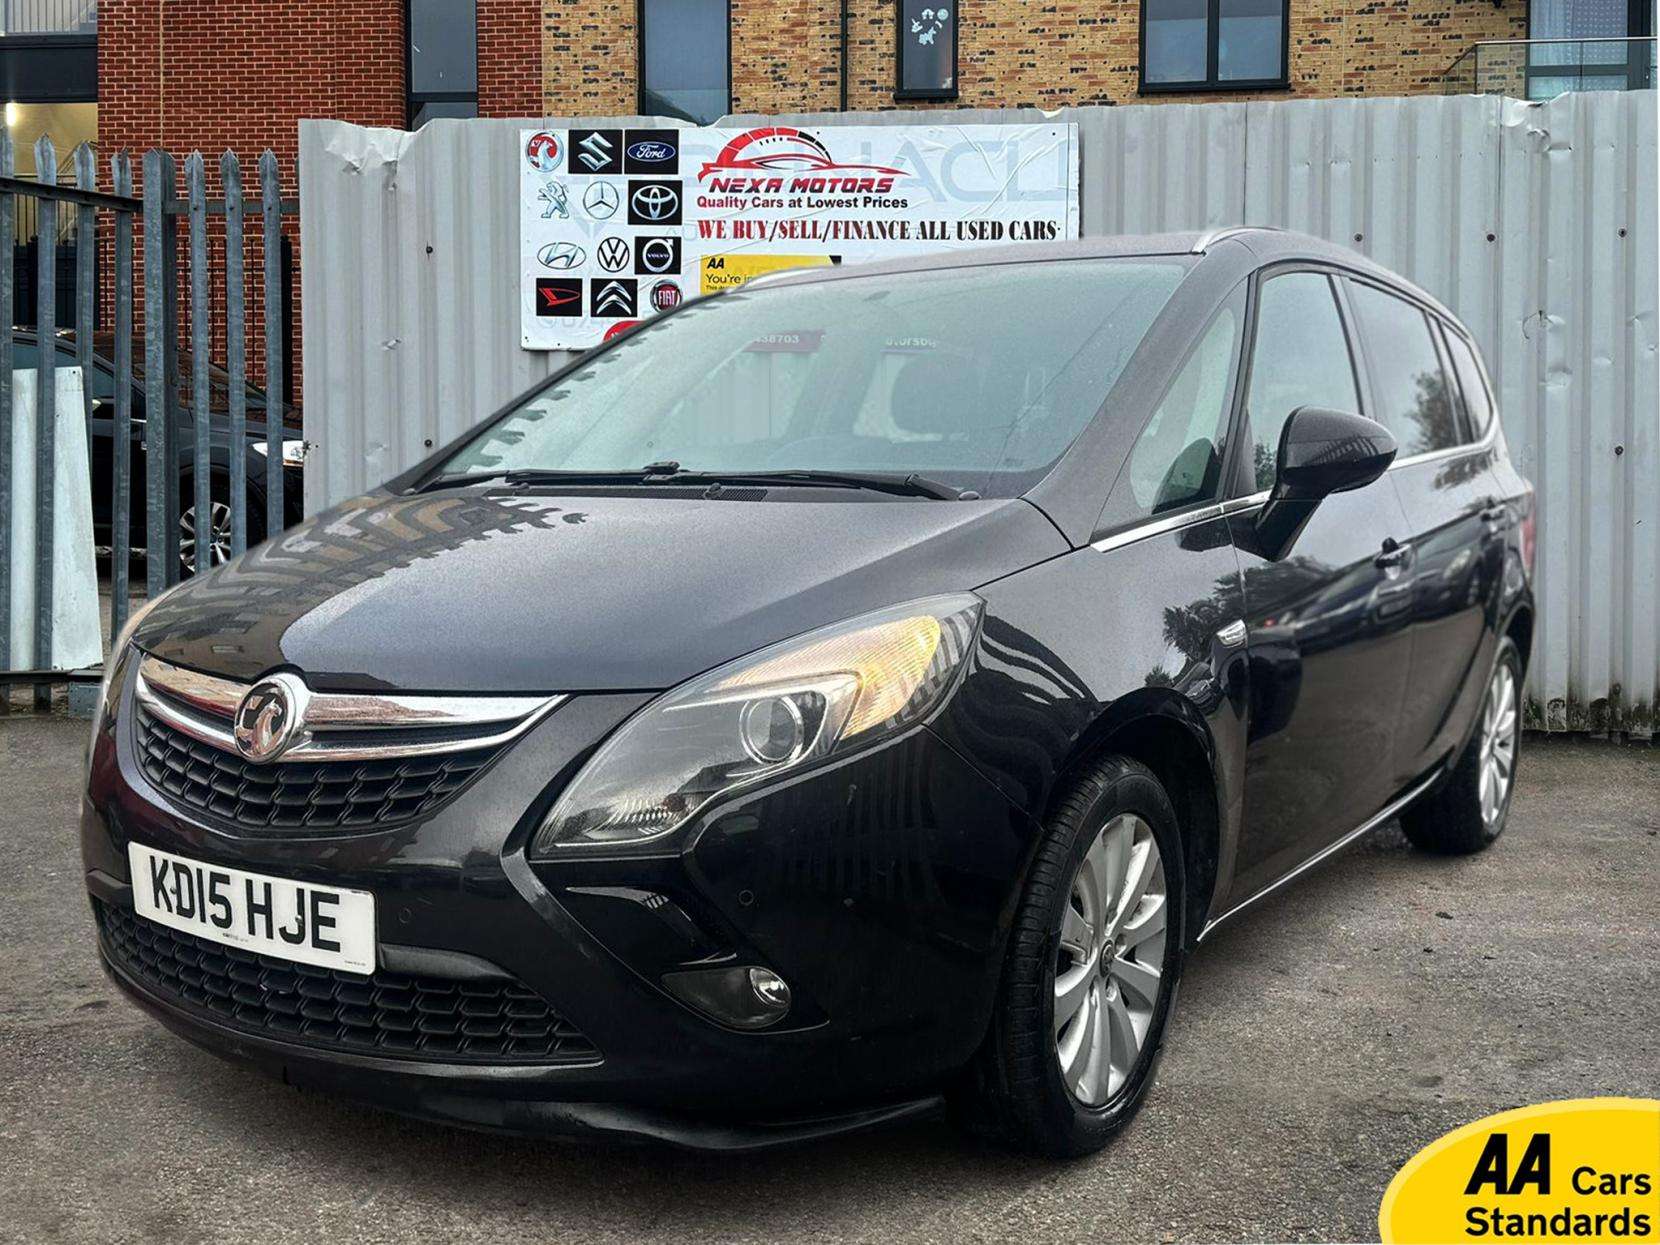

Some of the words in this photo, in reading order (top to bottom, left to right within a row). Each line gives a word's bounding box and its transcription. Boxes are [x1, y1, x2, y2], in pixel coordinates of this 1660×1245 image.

[636, 144, 666, 159] Ford
[709, 178, 781, 193] NEXA
[790, 178, 894, 193] MOTORS
[697, 196, 747, 210] Quality
[752, 196, 784, 208] Cars
[788, 197, 803, 208] at
[807, 196, 858, 208] Lowest
[863, 196, 908, 208] Prices
[698, 220, 727, 240] WE
[733, 220, 911, 242] BUY/SELL/FINANCE
[916, 221, 953, 240] ALL
[957, 221, 1003, 240] USED
[1009, 221, 1057, 240] CARS
[707, 257, 725, 269] AA
[706, 274, 741, 284] You're
[658, 290, 675, 306] FIAT
[150, 855, 233, 929] KD15
[245, 878, 341, 953] HJE
